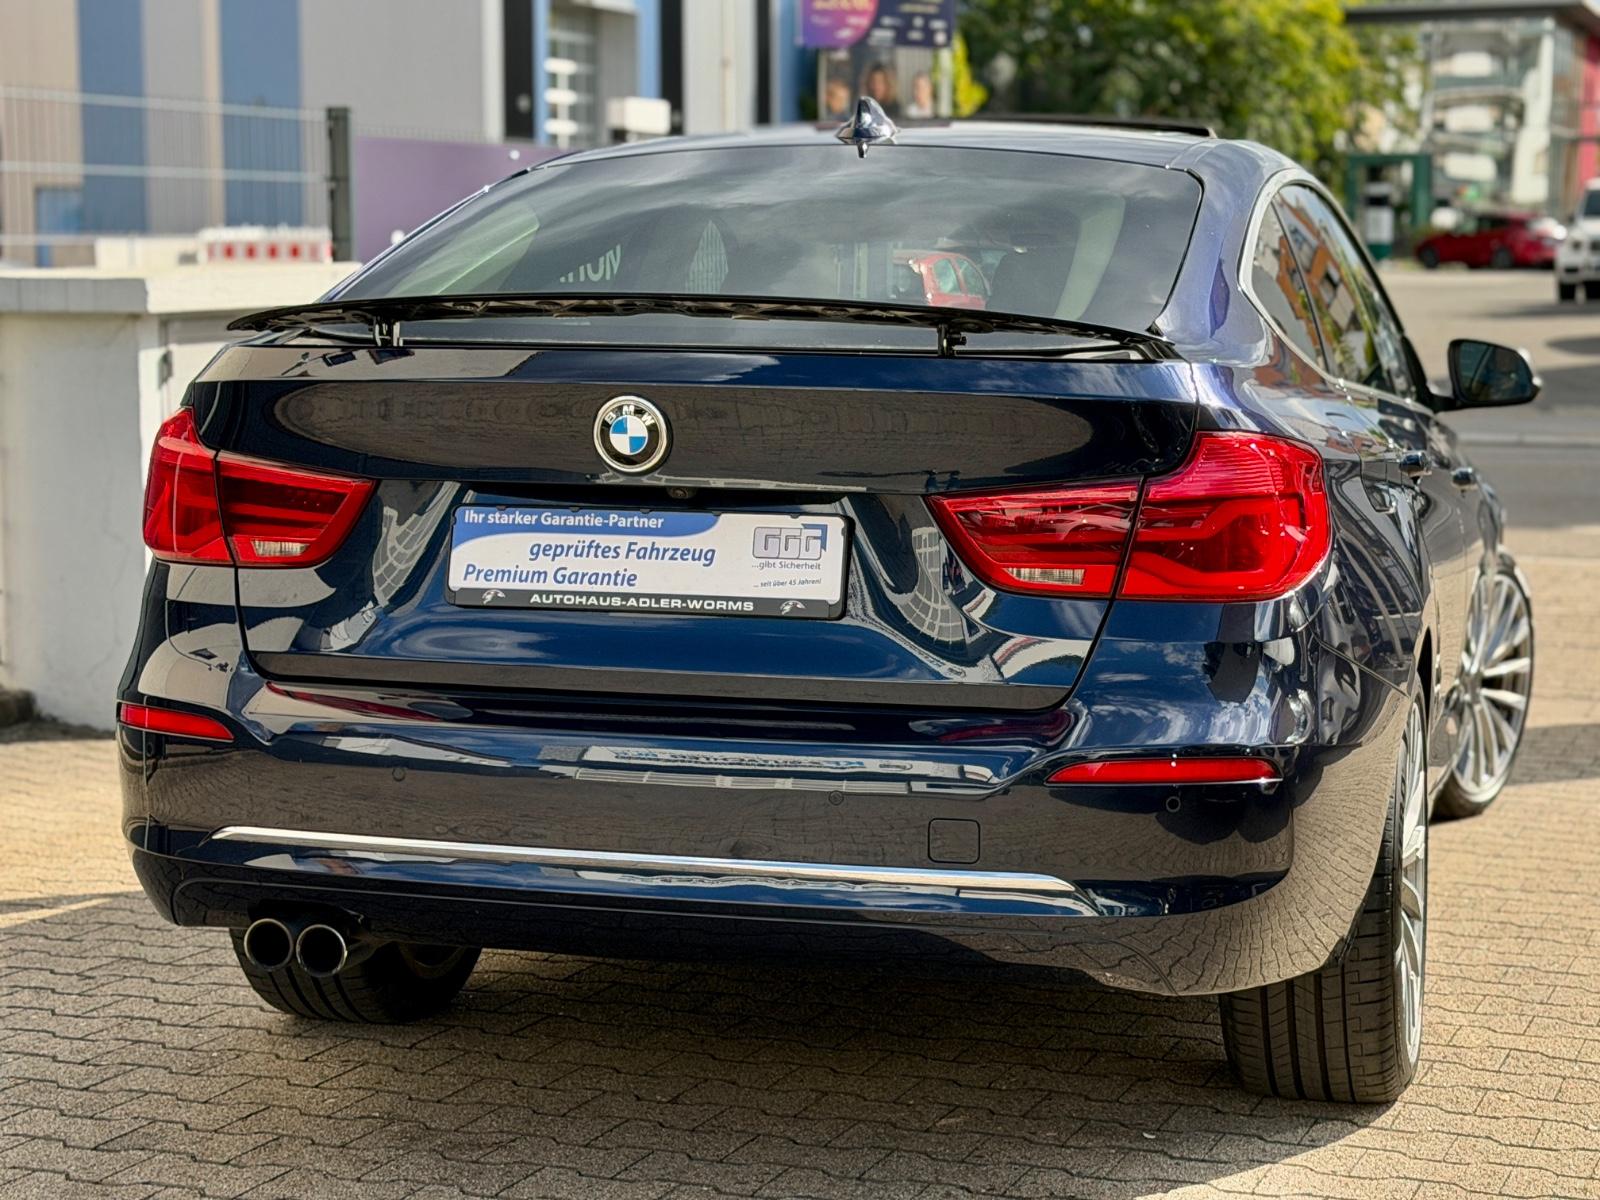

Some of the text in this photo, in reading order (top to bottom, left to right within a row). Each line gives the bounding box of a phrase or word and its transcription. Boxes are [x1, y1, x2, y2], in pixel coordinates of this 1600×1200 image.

[604, 404, 655, 426] BMW
[464, 509, 665, 528] Ihr starker Garantie-Partner
[529, 539, 717, 567] geprüftes Fahrzeug
[463, 563, 638, 588] Premium Garantie
[778, 560, 822, 571] Sicherheit
[529, 593, 755, 612] AUTOHAUS-ADLER-WORMS
